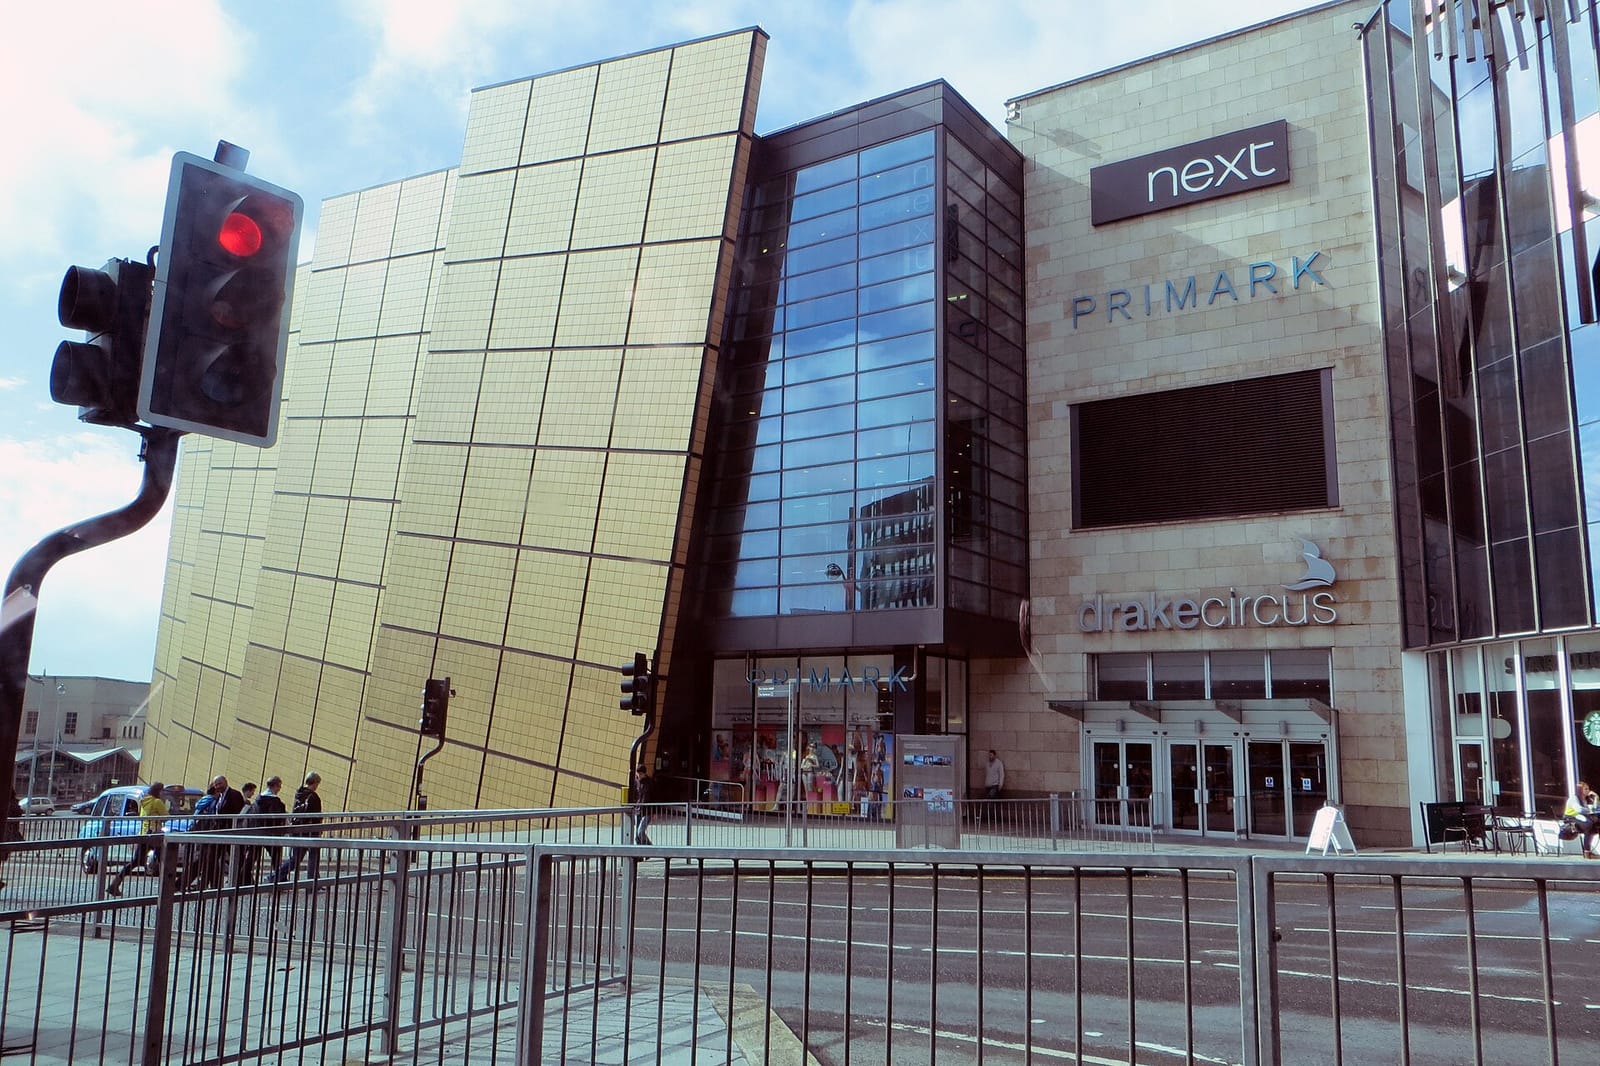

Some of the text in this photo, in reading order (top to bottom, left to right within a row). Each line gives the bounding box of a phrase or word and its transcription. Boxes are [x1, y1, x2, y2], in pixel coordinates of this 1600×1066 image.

[1148, 141, 1276, 202] next
[913, 164, 929, 270] next
[1072, 250, 1324, 329] PRIMARK
[748, 665, 908, 695] PRIMARK
